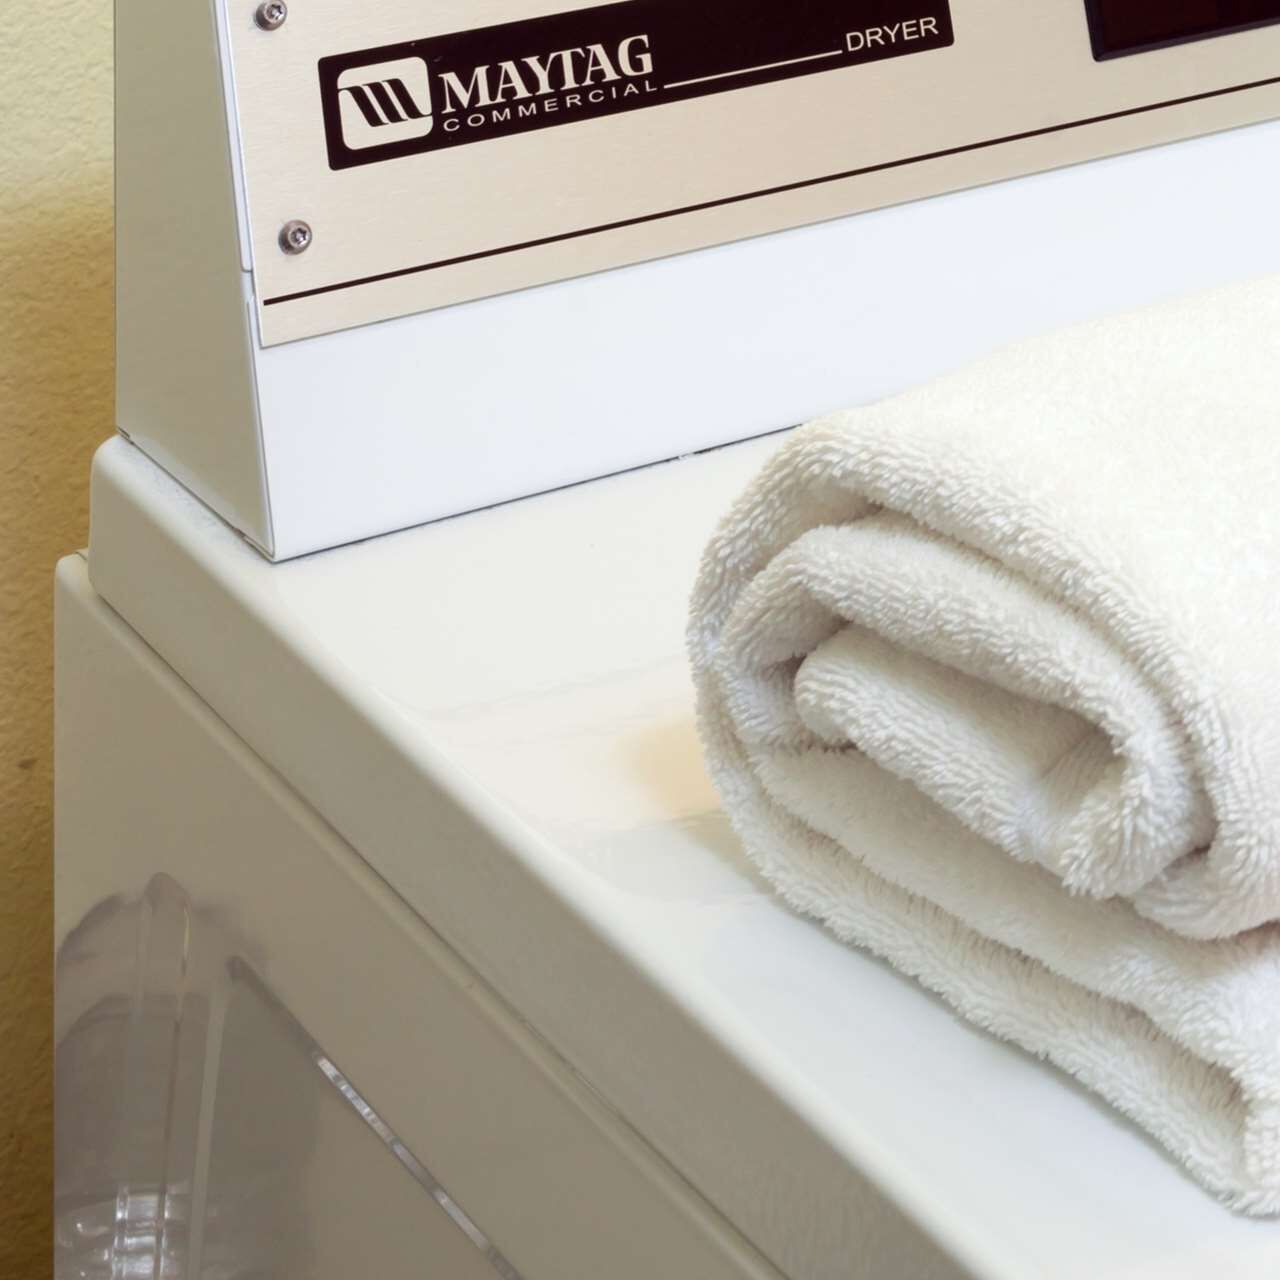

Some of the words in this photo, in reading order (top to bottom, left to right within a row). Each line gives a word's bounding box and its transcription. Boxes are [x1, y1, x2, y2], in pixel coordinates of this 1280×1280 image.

[845, 15, 939, 54] DRYER
[441, 34, 654, 114] MAYTAG
[443, 79, 659, 132] COMMERCIAL
